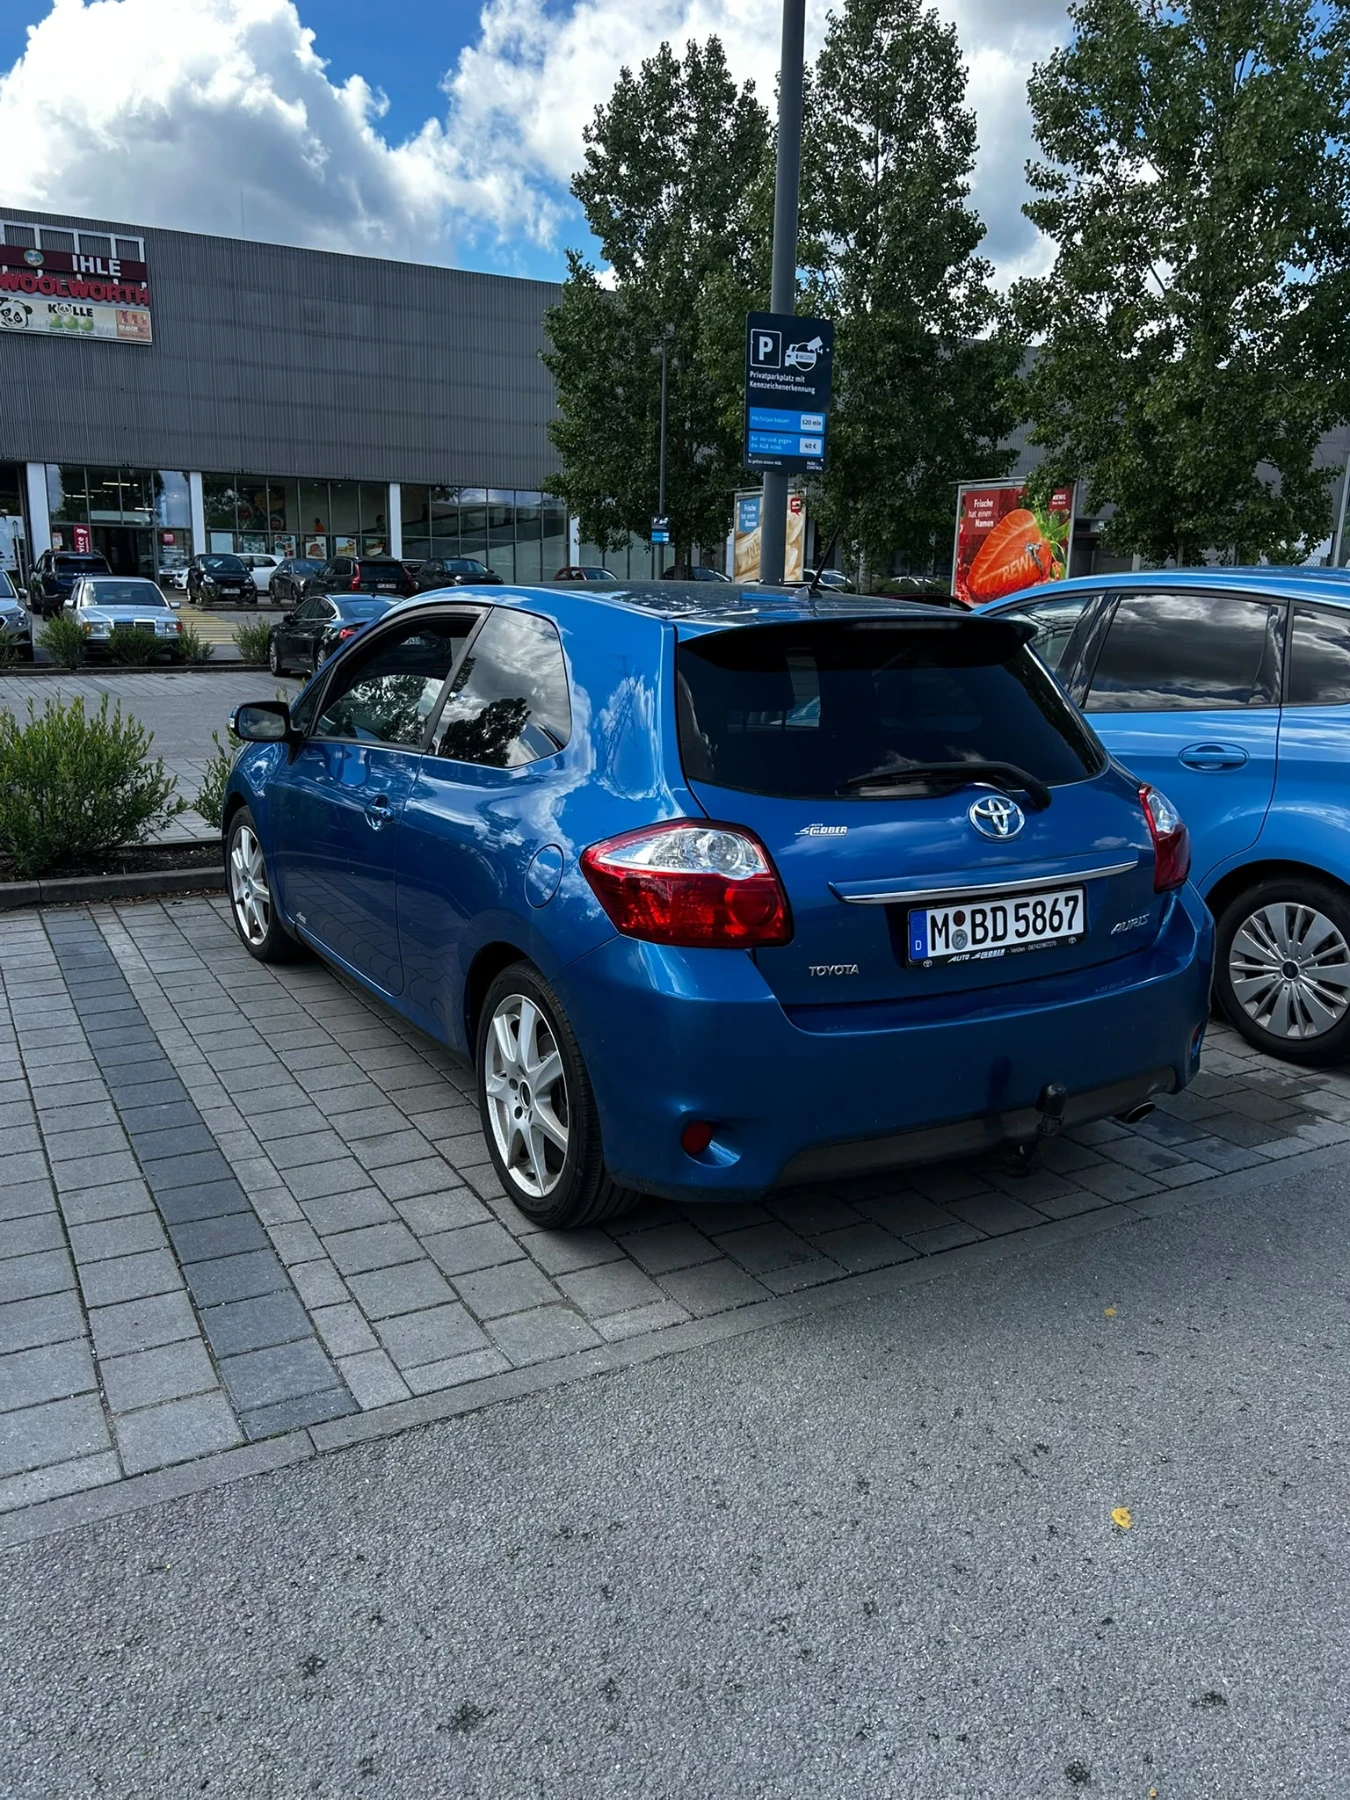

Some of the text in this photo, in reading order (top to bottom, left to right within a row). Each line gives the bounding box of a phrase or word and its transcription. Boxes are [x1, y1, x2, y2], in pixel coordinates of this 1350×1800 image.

[72, 254, 121, 276] IHLE
[0, 271, 150, 307] WOOLWORTH
[758, 336, 773, 361] P
[749, 370, 805, 383] Privatparkplatz mit
[749, 380, 815, 394] Kennzeichenerkennung
[974, 499, 993, 508] Frische
[968, 510, 977, 518] hat
[975, 519, 993, 527] Namen
[930, 912, 950, 951] M
[1014, 895, 1080, 939] 5867
[1110, 913, 1150, 935] AURIS
[915, 940, 922, 951] D
[947, 953, 970, 963] AUTO
[808, 963, 859, 977] TOYOTA
